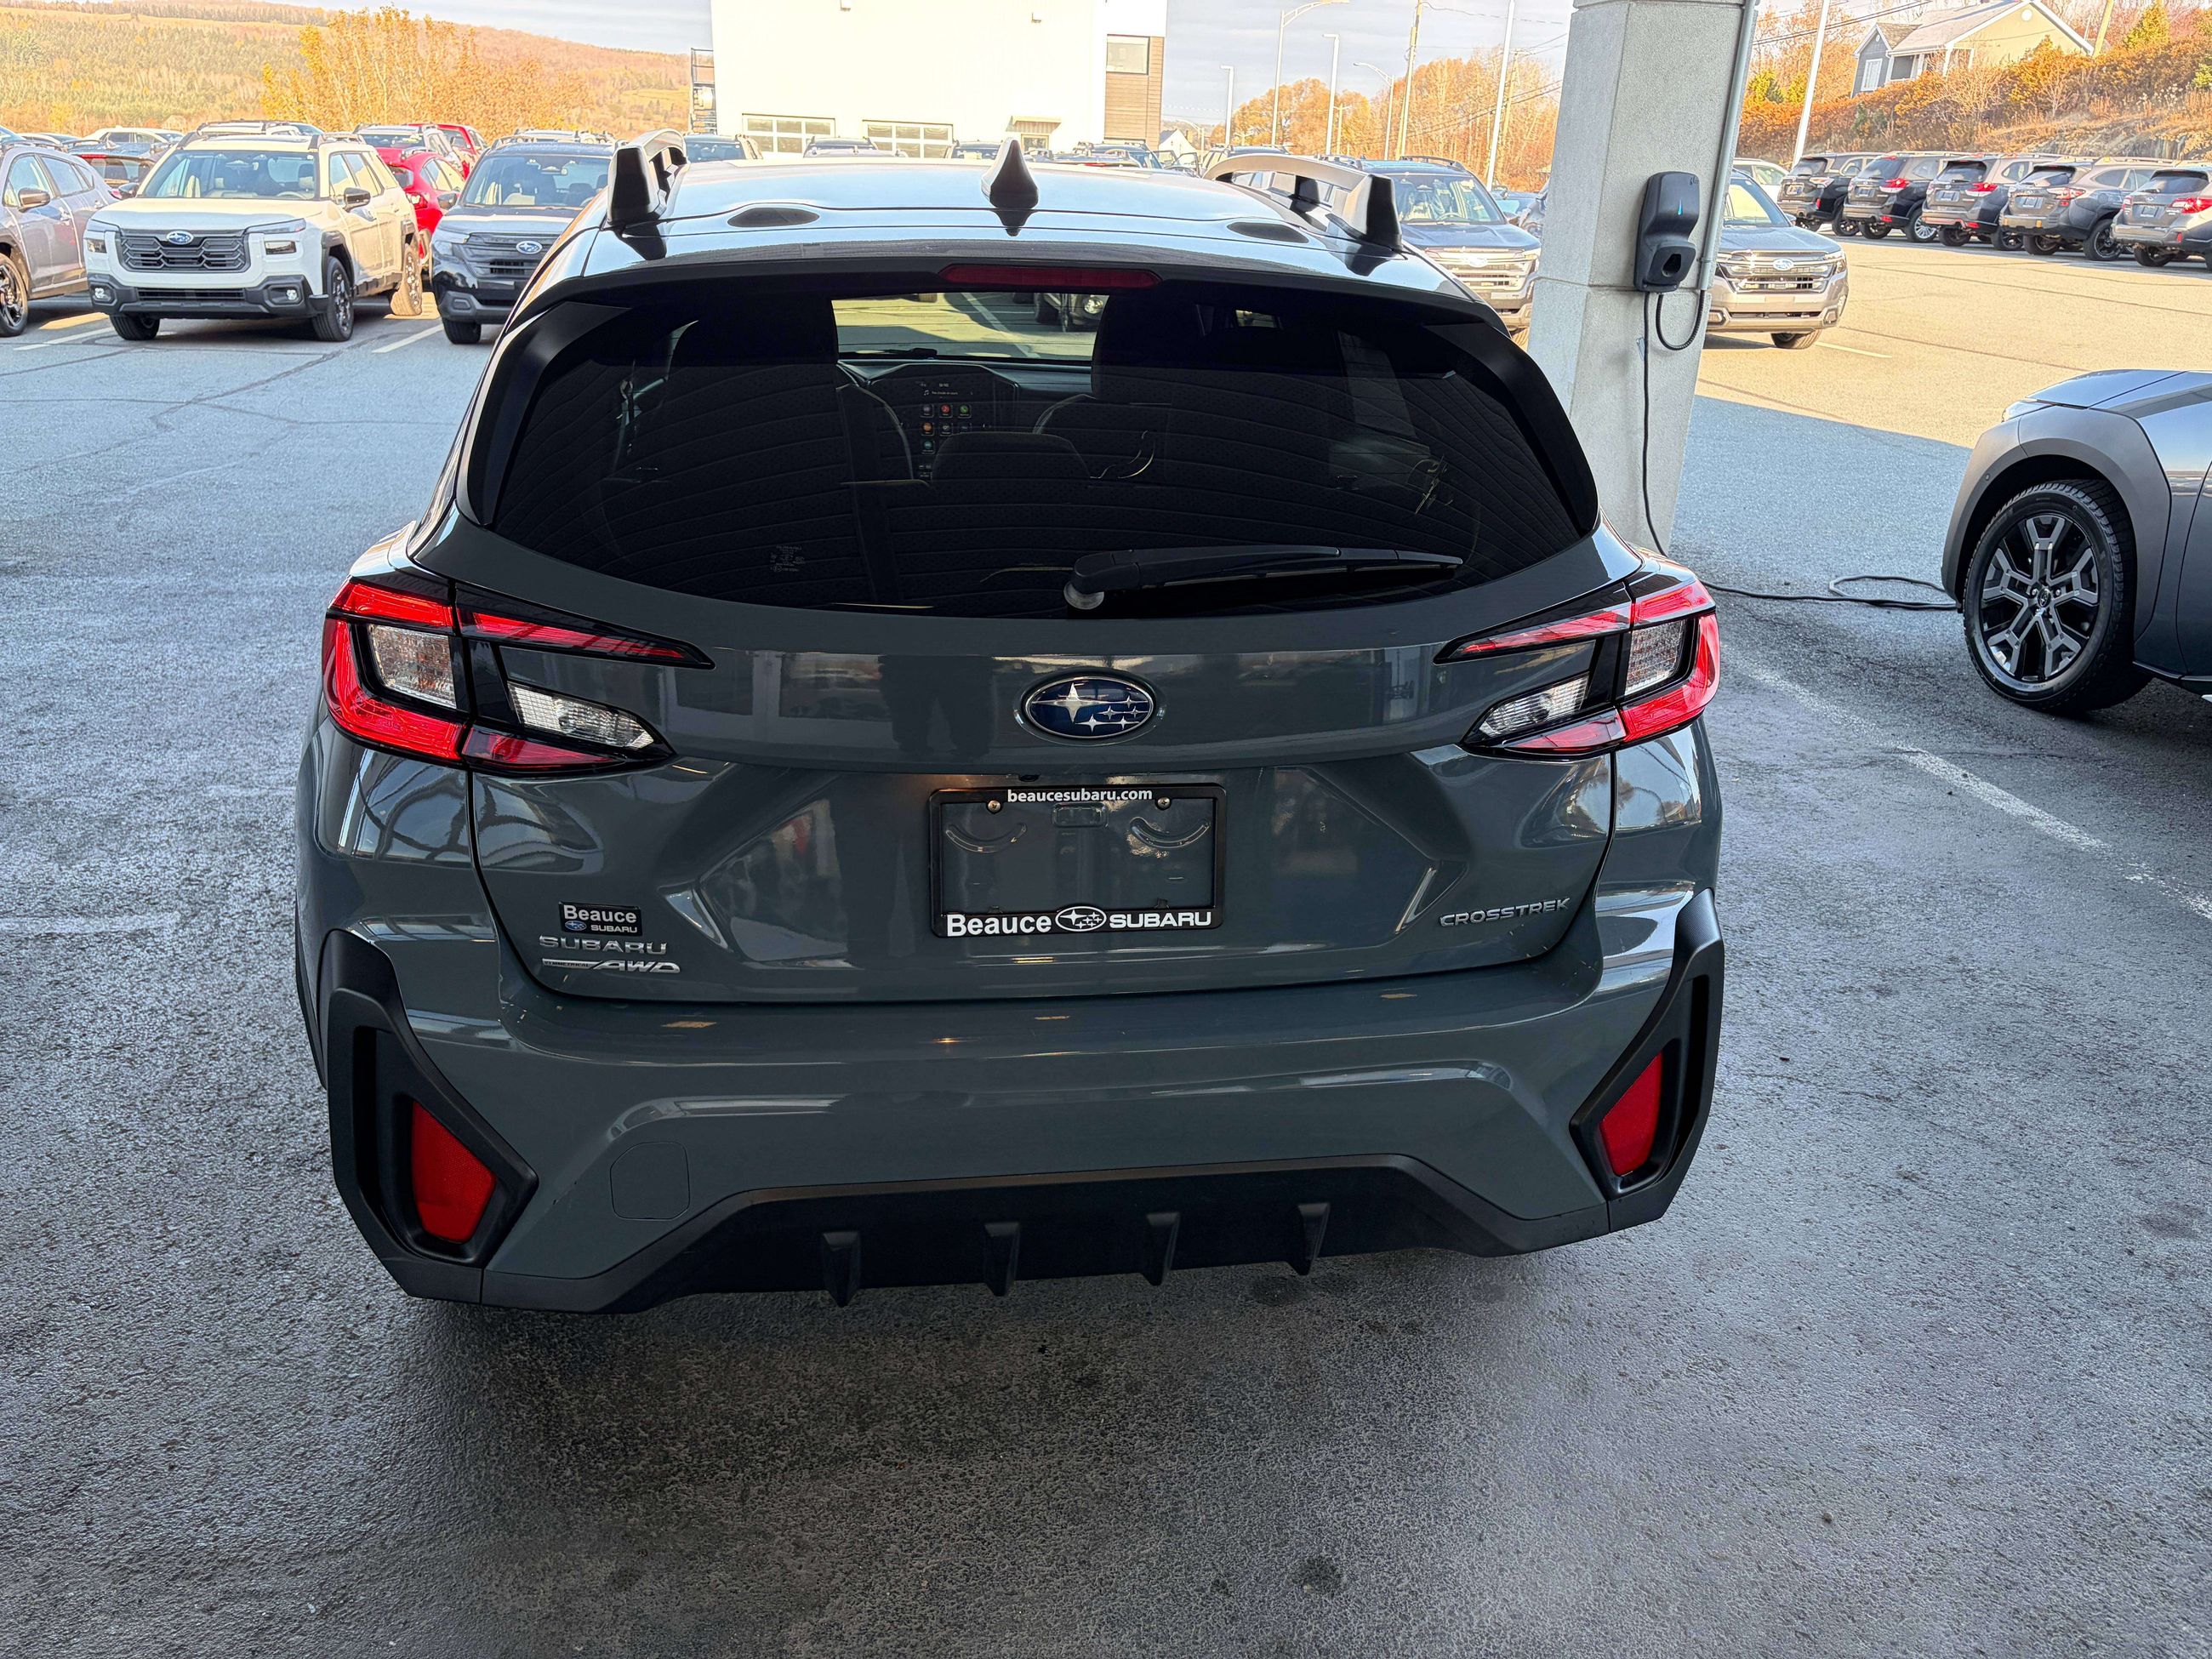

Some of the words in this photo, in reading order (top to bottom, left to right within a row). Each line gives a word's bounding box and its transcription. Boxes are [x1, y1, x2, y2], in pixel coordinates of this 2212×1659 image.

[1006, 788, 1153, 803] beaucesubaru.com
[563, 904, 637, 923] Beauce
[1440, 898, 1571, 927] CROSSTREK
[590, 924, 638, 933] SUBARU
[946, 913, 1052, 937] Beauce
[1109, 911, 1211, 929] SUBARU
[539, 935, 668, 955] SUBARU
[593, 959, 681, 974] AWD
